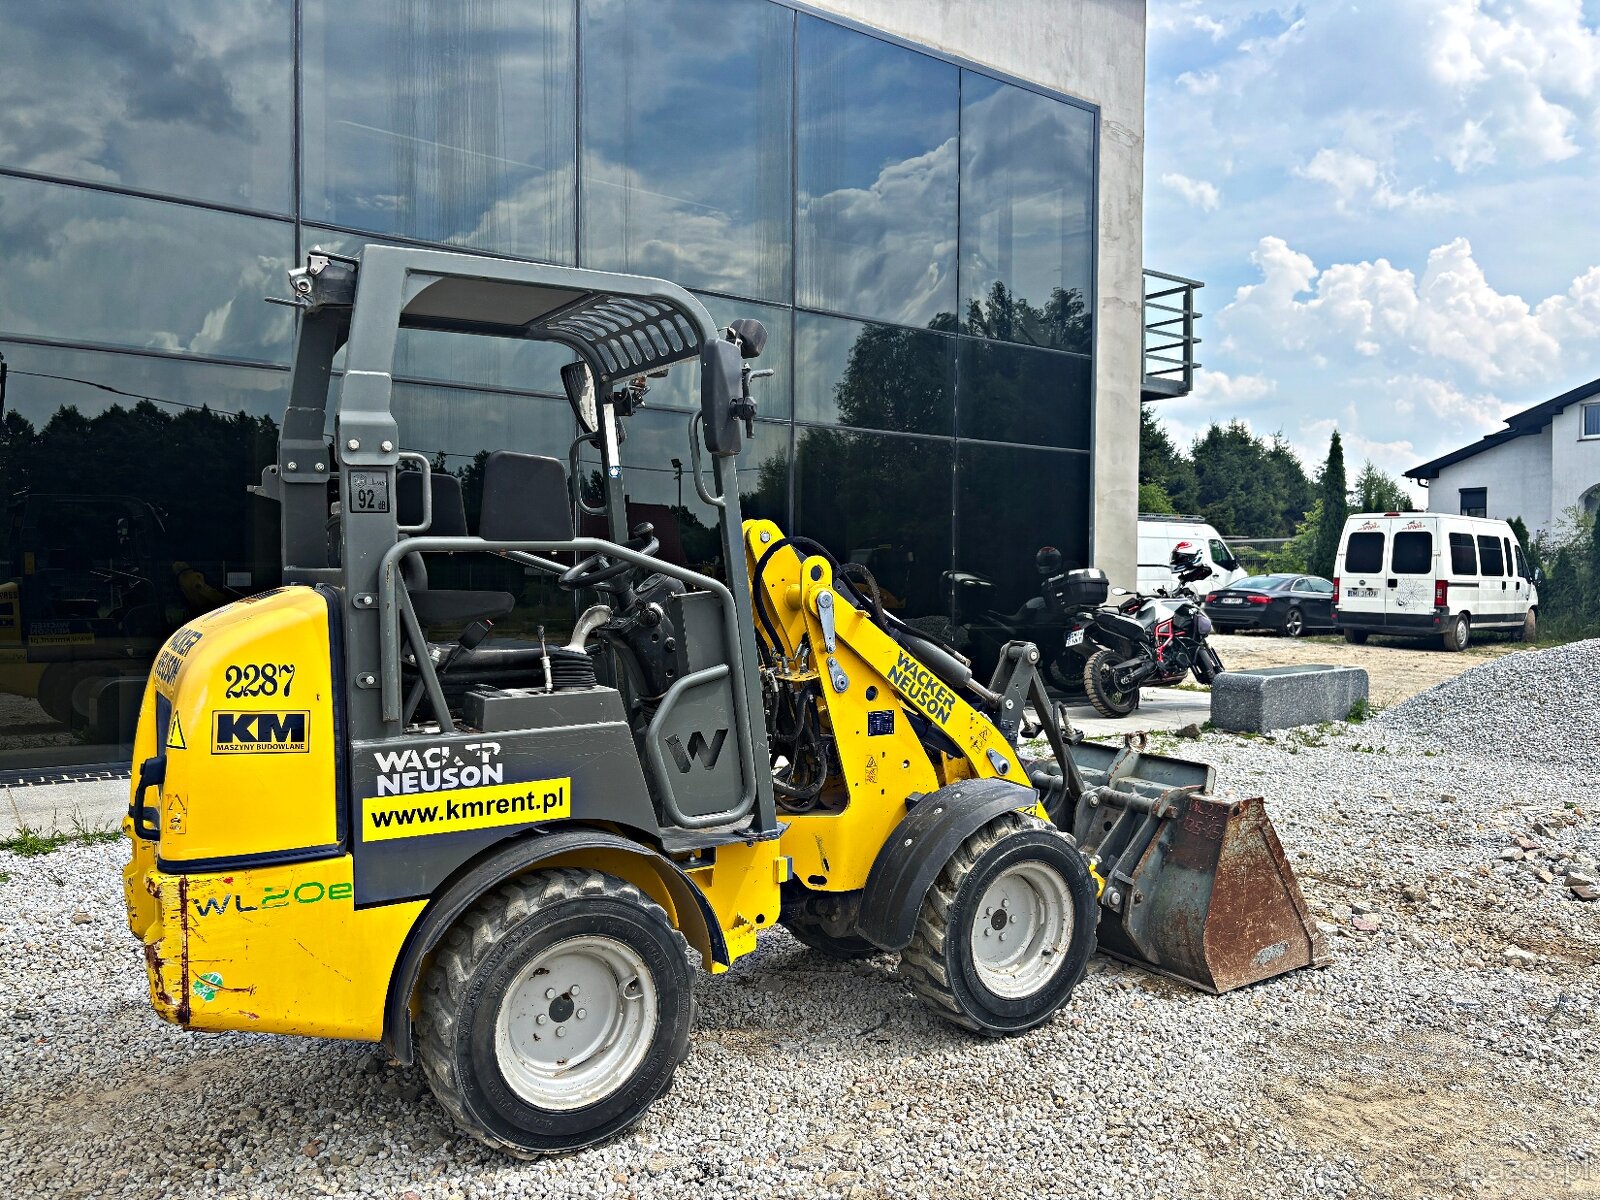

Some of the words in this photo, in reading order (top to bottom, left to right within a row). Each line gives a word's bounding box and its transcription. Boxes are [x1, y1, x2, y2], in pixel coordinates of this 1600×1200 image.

[358, 489, 375, 509] 92
[377, 500, 386, 510] dB
[225, 663, 296, 699] 2287
[887, 665, 951, 725] NEUSON
[897, 650, 956, 711] WACKER
[217, 713, 306, 743] KM
[216, 743, 255, 751] MASZYNY
[256, 743, 305, 751] BUDOWLANE
[376, 763, 504, 797] NEUSON
[371, 786, 564, 828] www.kmrent.pl
